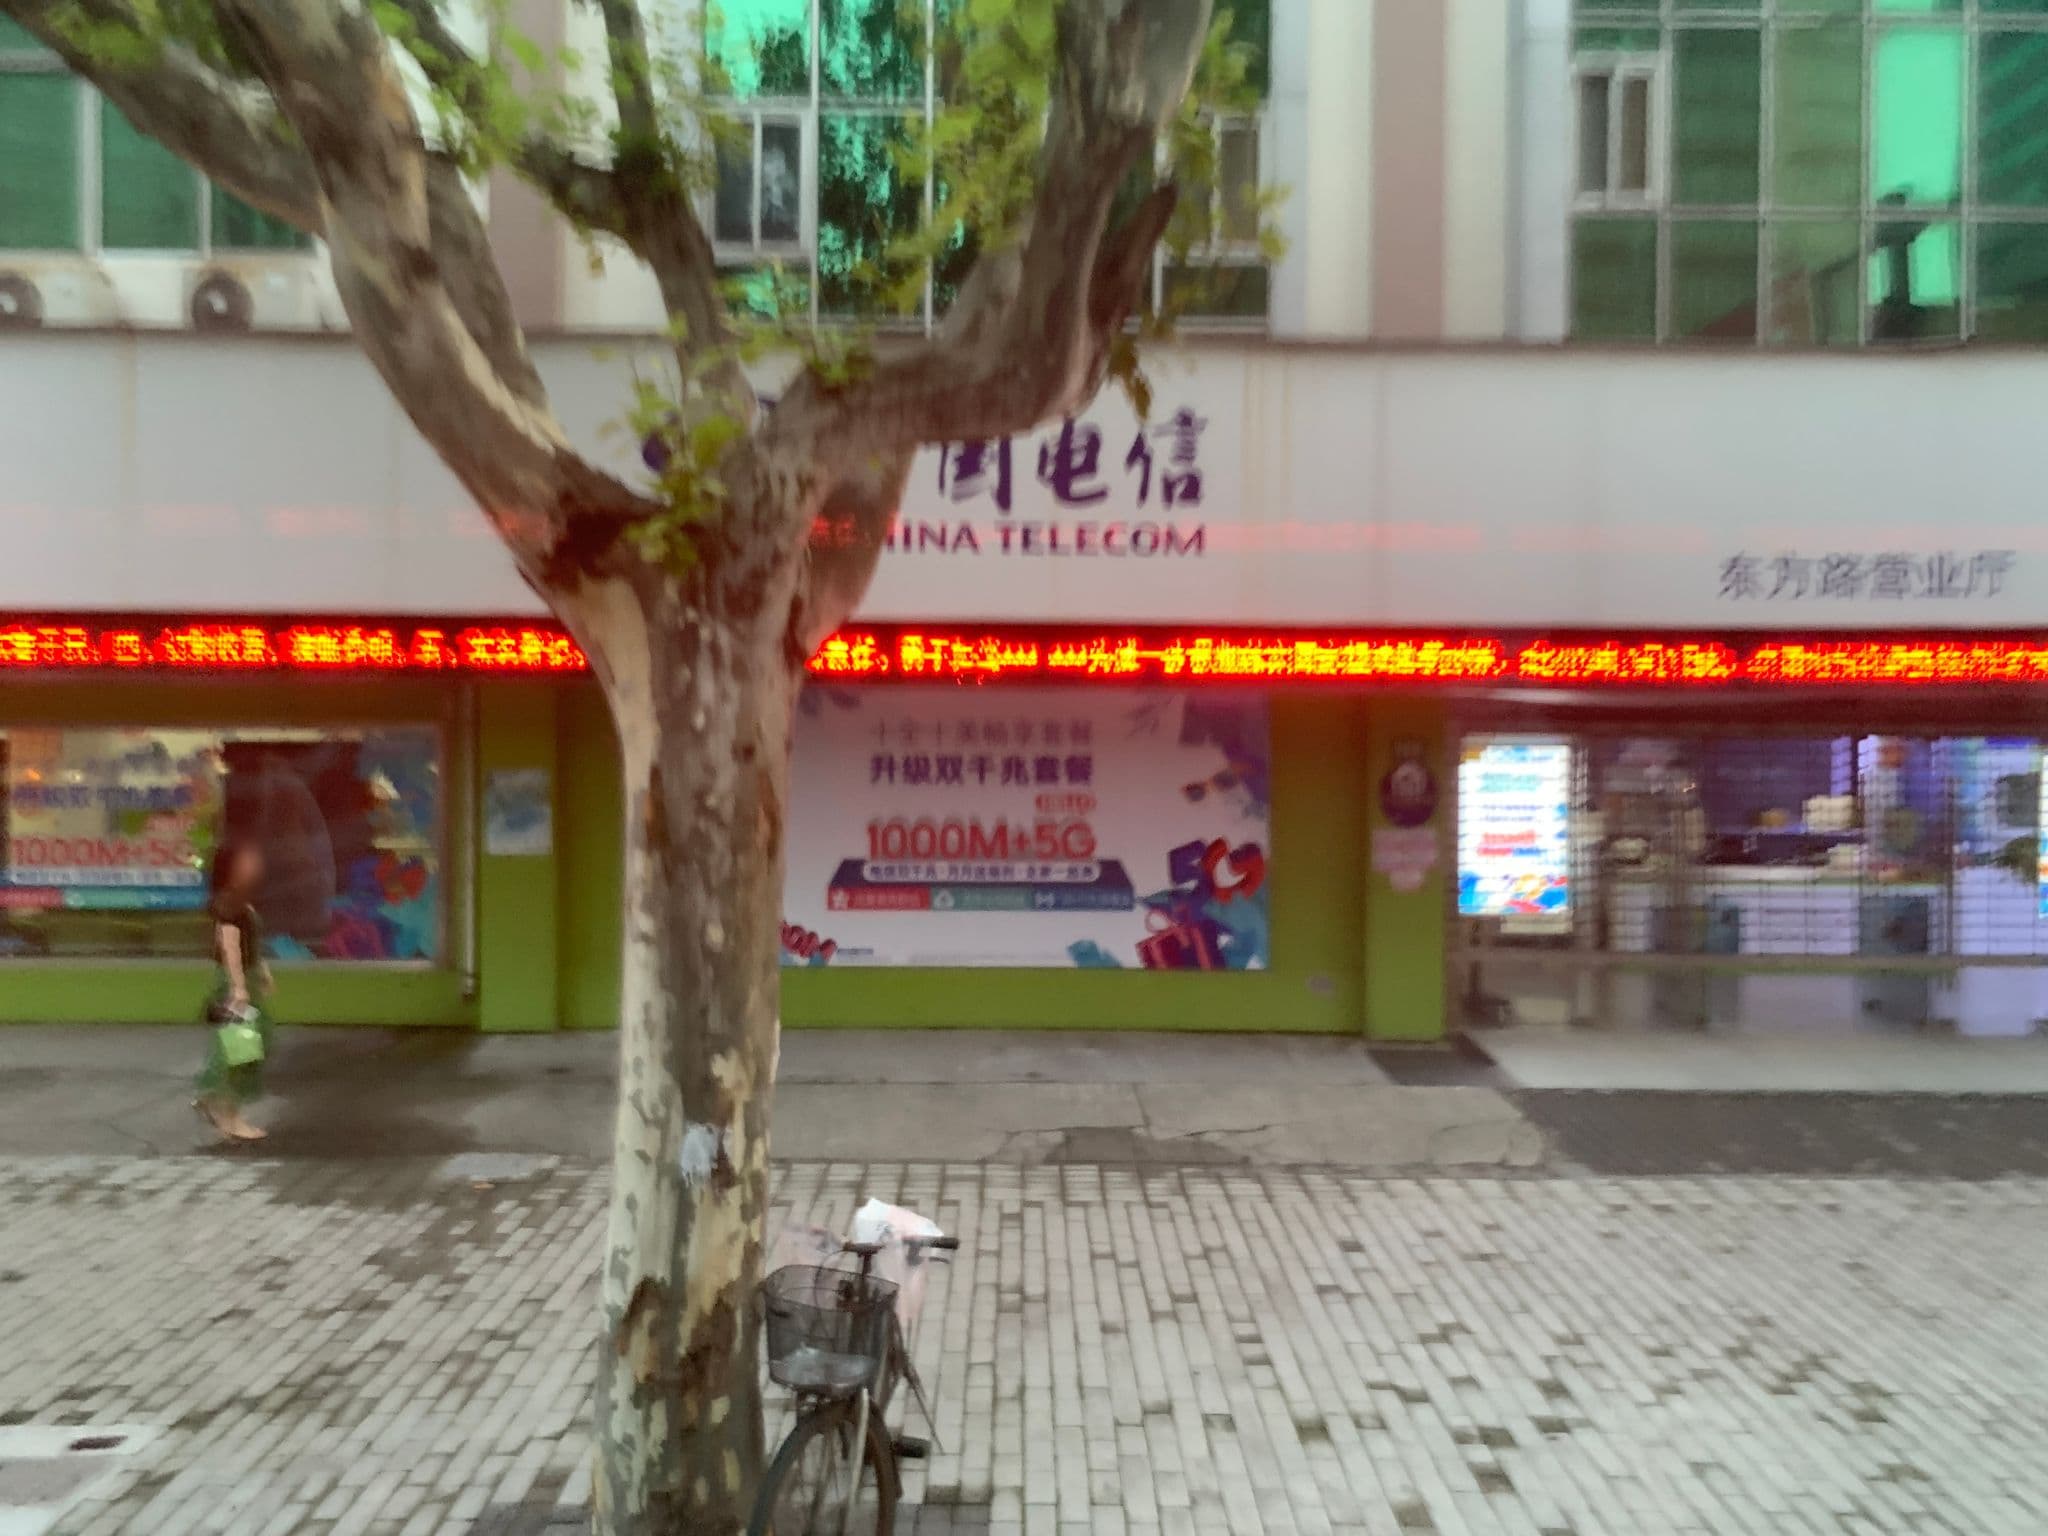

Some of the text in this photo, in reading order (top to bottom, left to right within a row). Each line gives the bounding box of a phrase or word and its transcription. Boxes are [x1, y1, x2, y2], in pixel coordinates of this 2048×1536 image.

[994, 519, 1208, 556] TELECOM
[1718, 550, 2016, 600] 东方路营业厅
[870, 754, 1093, 785] 升级双千兆套餐
[866, 819, 1097, 861] 1000M+5G
